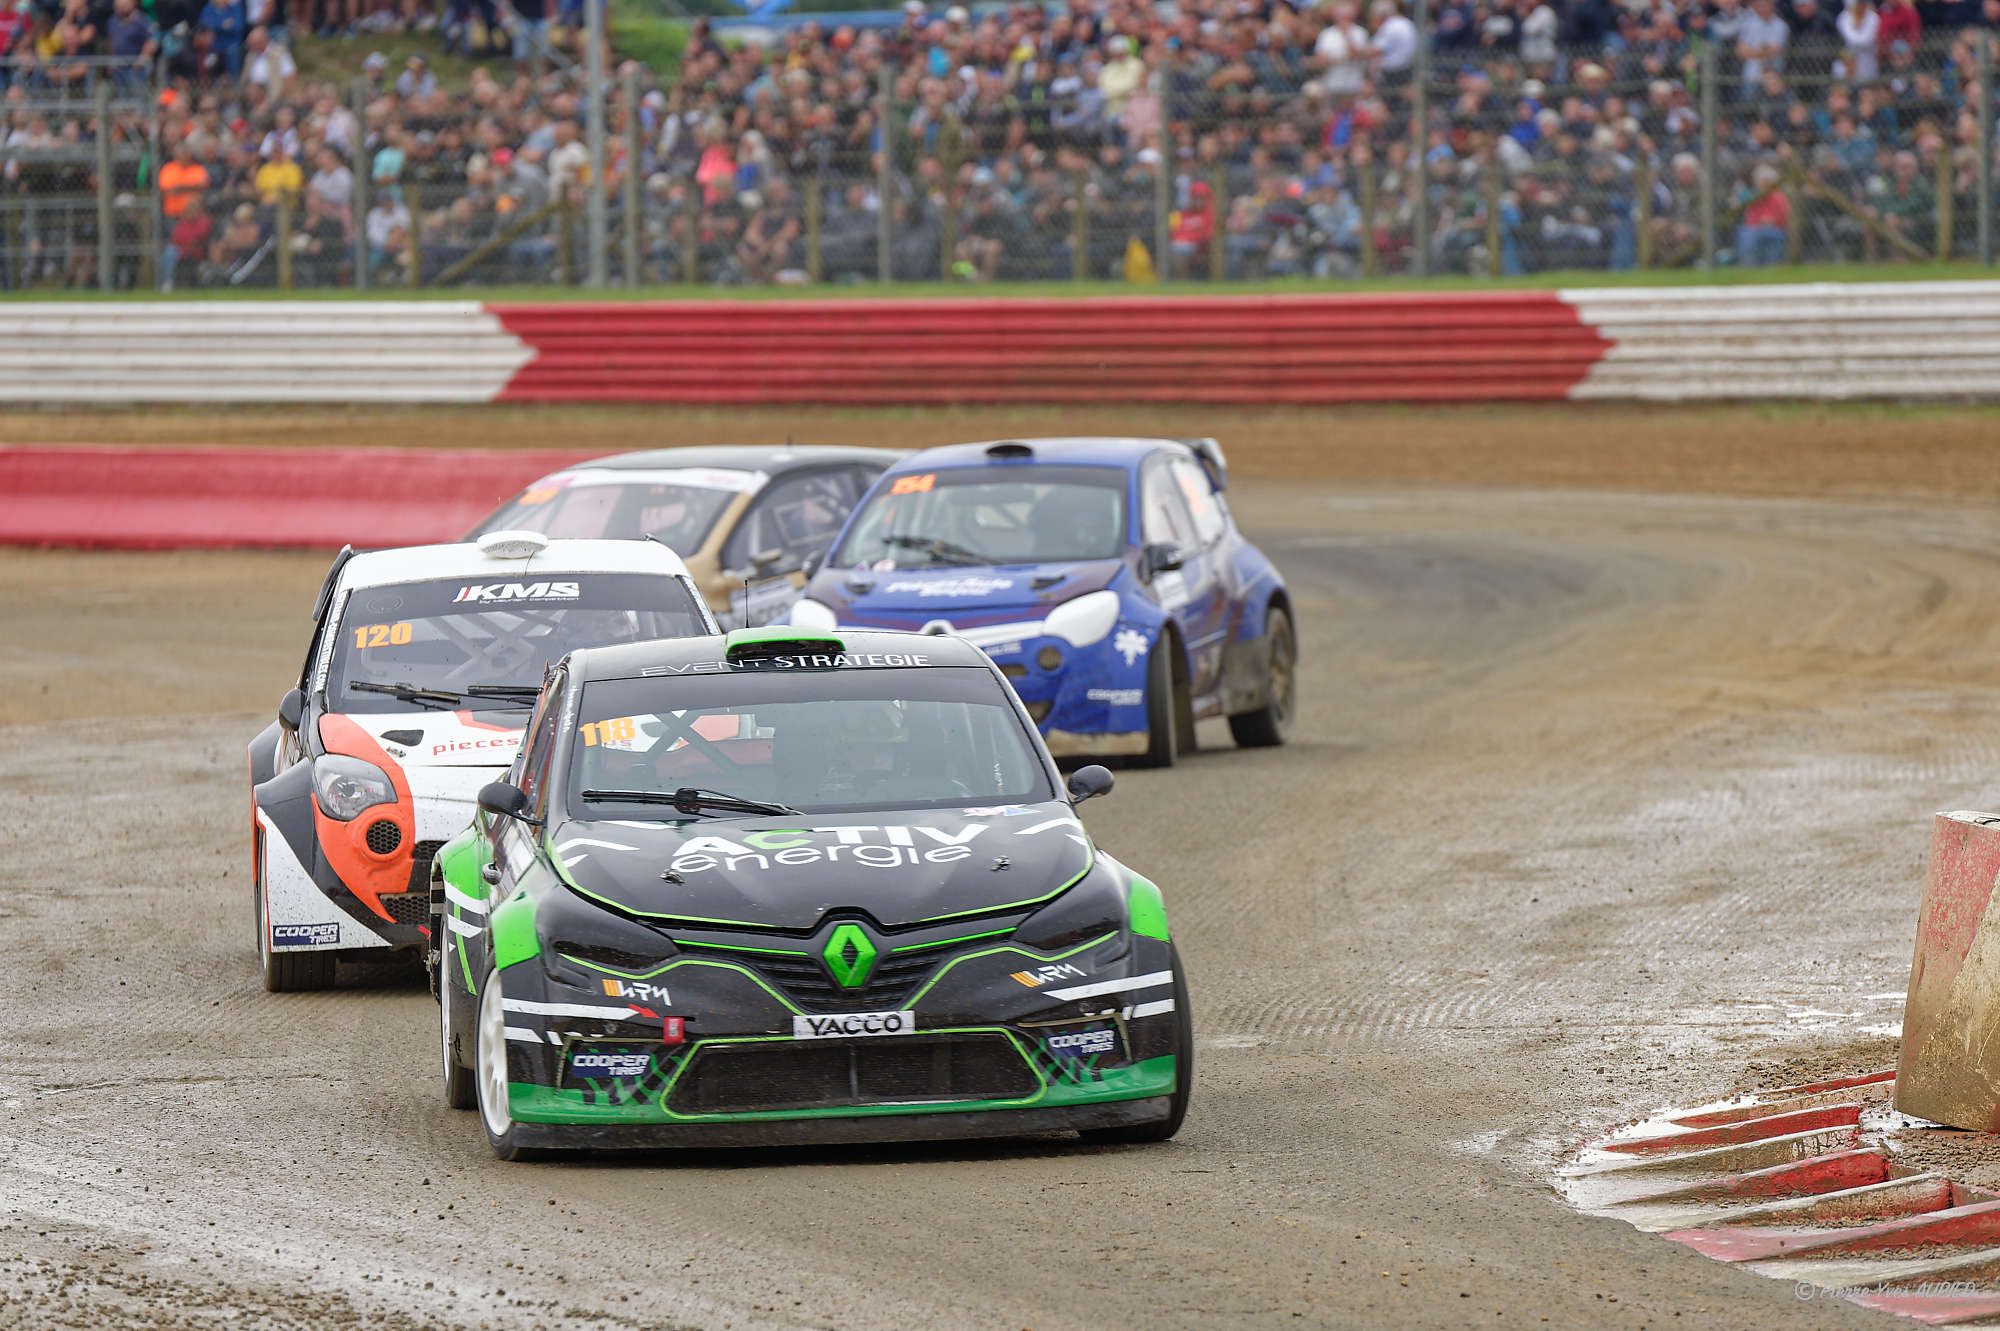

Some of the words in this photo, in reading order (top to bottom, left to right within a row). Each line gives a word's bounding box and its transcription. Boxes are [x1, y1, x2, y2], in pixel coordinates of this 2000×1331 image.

[355, 623, 413, 649] 120
[641, 657, 768, 677] EVENT
[774, 654, 932, 668] STRATEGIE
[579, 717, 636, 747] 118
[433, 738, 519, 756] pieces
[672, 823, 990, 857] ACTIV
[670, 845, 972, 872] energie
[274, 924, 338, 937] COOPER
[309, 934, 337, 945] TIRES
[806, 1014, 902, 1036] YACCO
[1048, 1030, 1114, 1048] COOPER
[1080, 1041, 1114, 1053] TIRES
[573, 1054, 651, 1067] COOPER
[608, 1066, 647, 1076] TIRES
